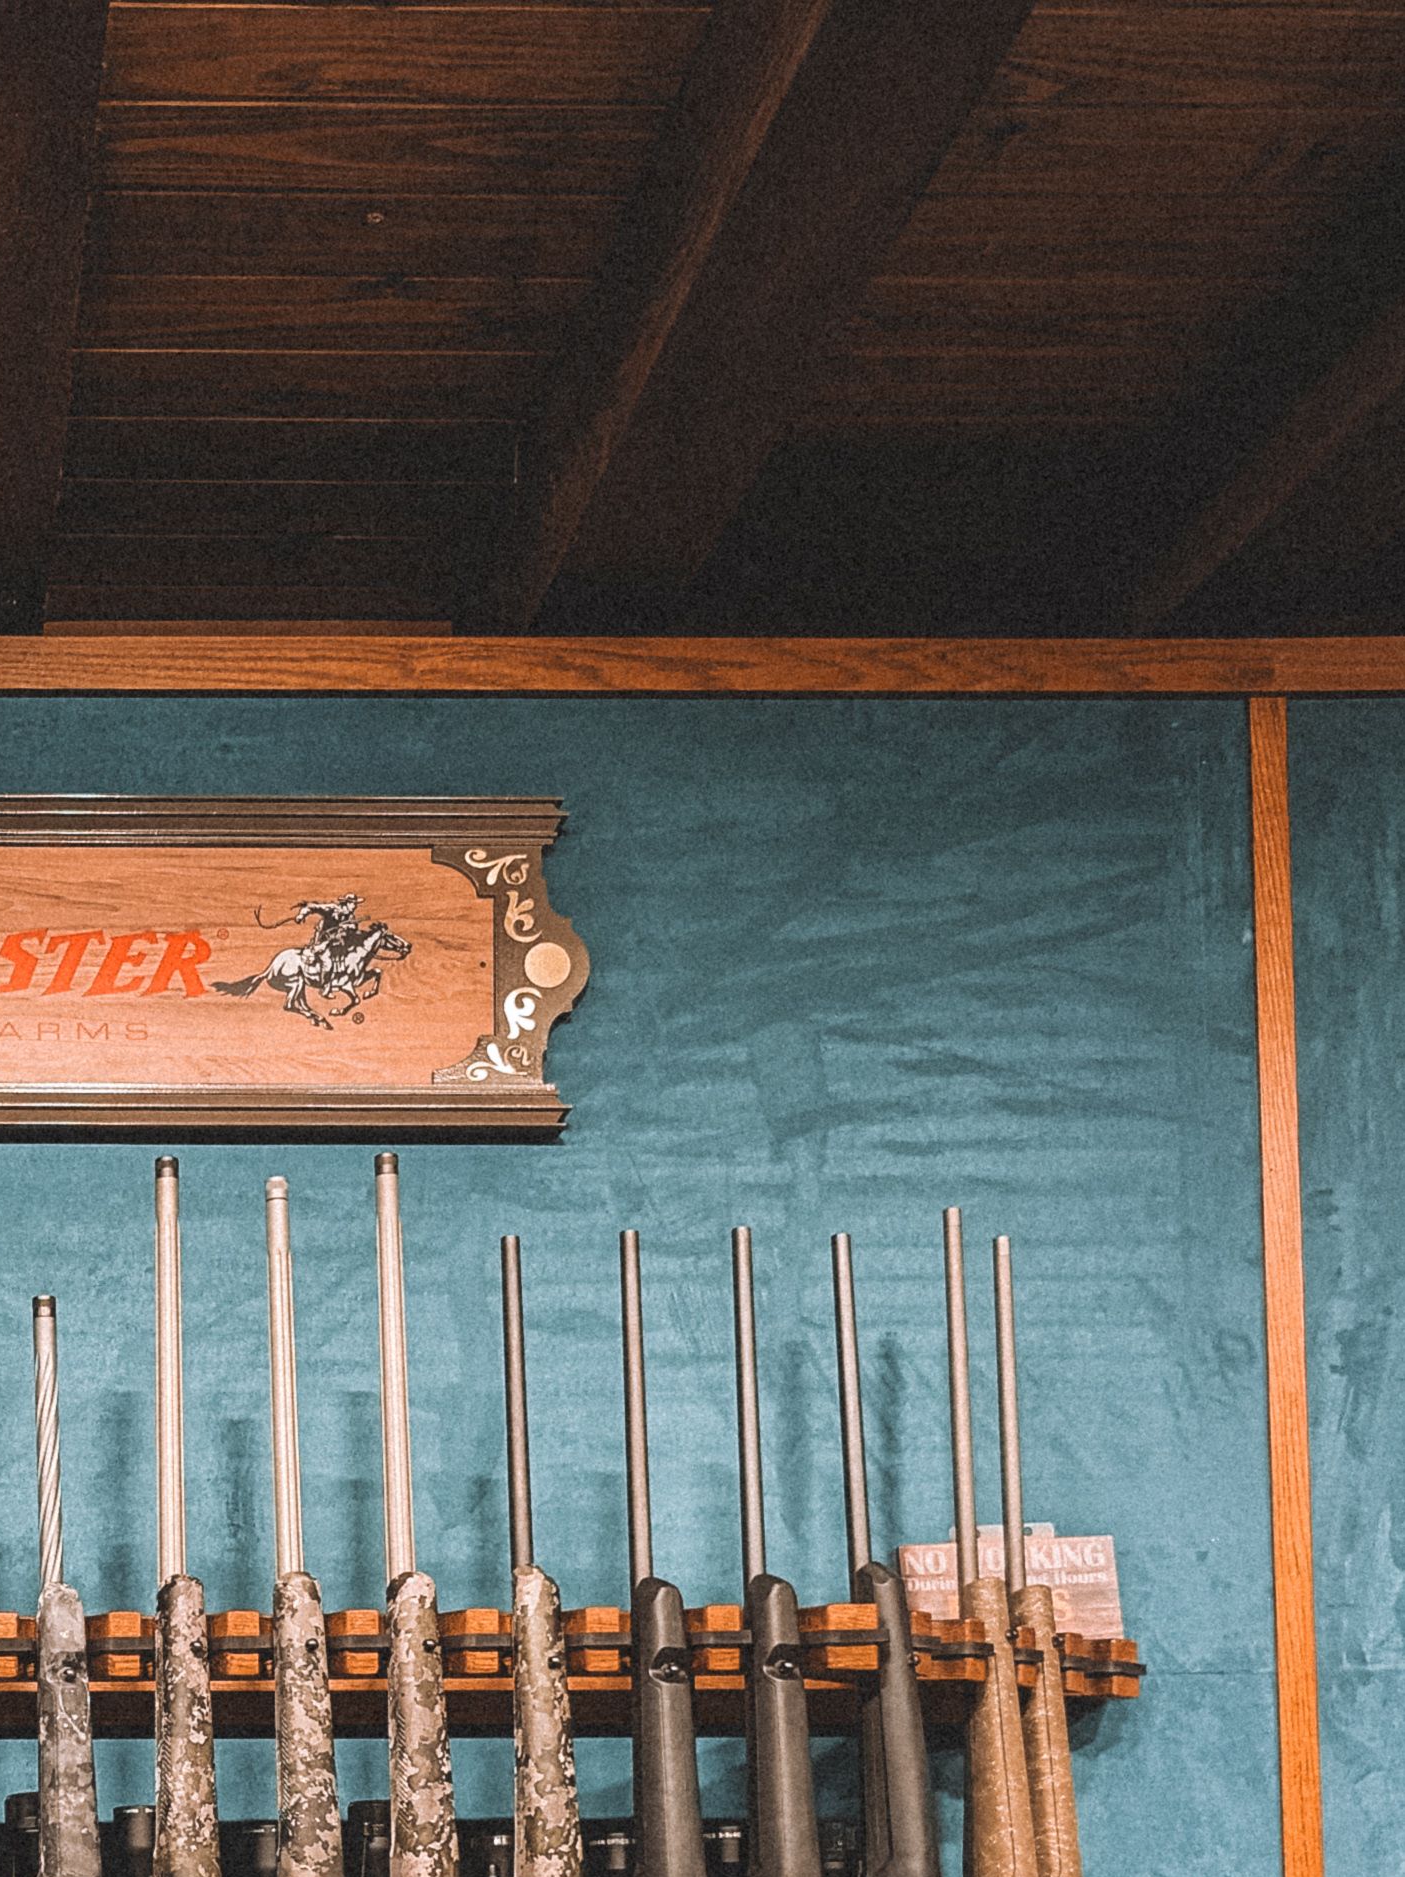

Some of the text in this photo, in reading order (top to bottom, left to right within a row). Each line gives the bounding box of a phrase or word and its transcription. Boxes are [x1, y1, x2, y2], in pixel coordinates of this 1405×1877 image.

[904, 1543, 1106, 1576] NO OKING
[907, 1578, 958, 1593] Durin
[1055, 1571, 1109, 1586] Hours
